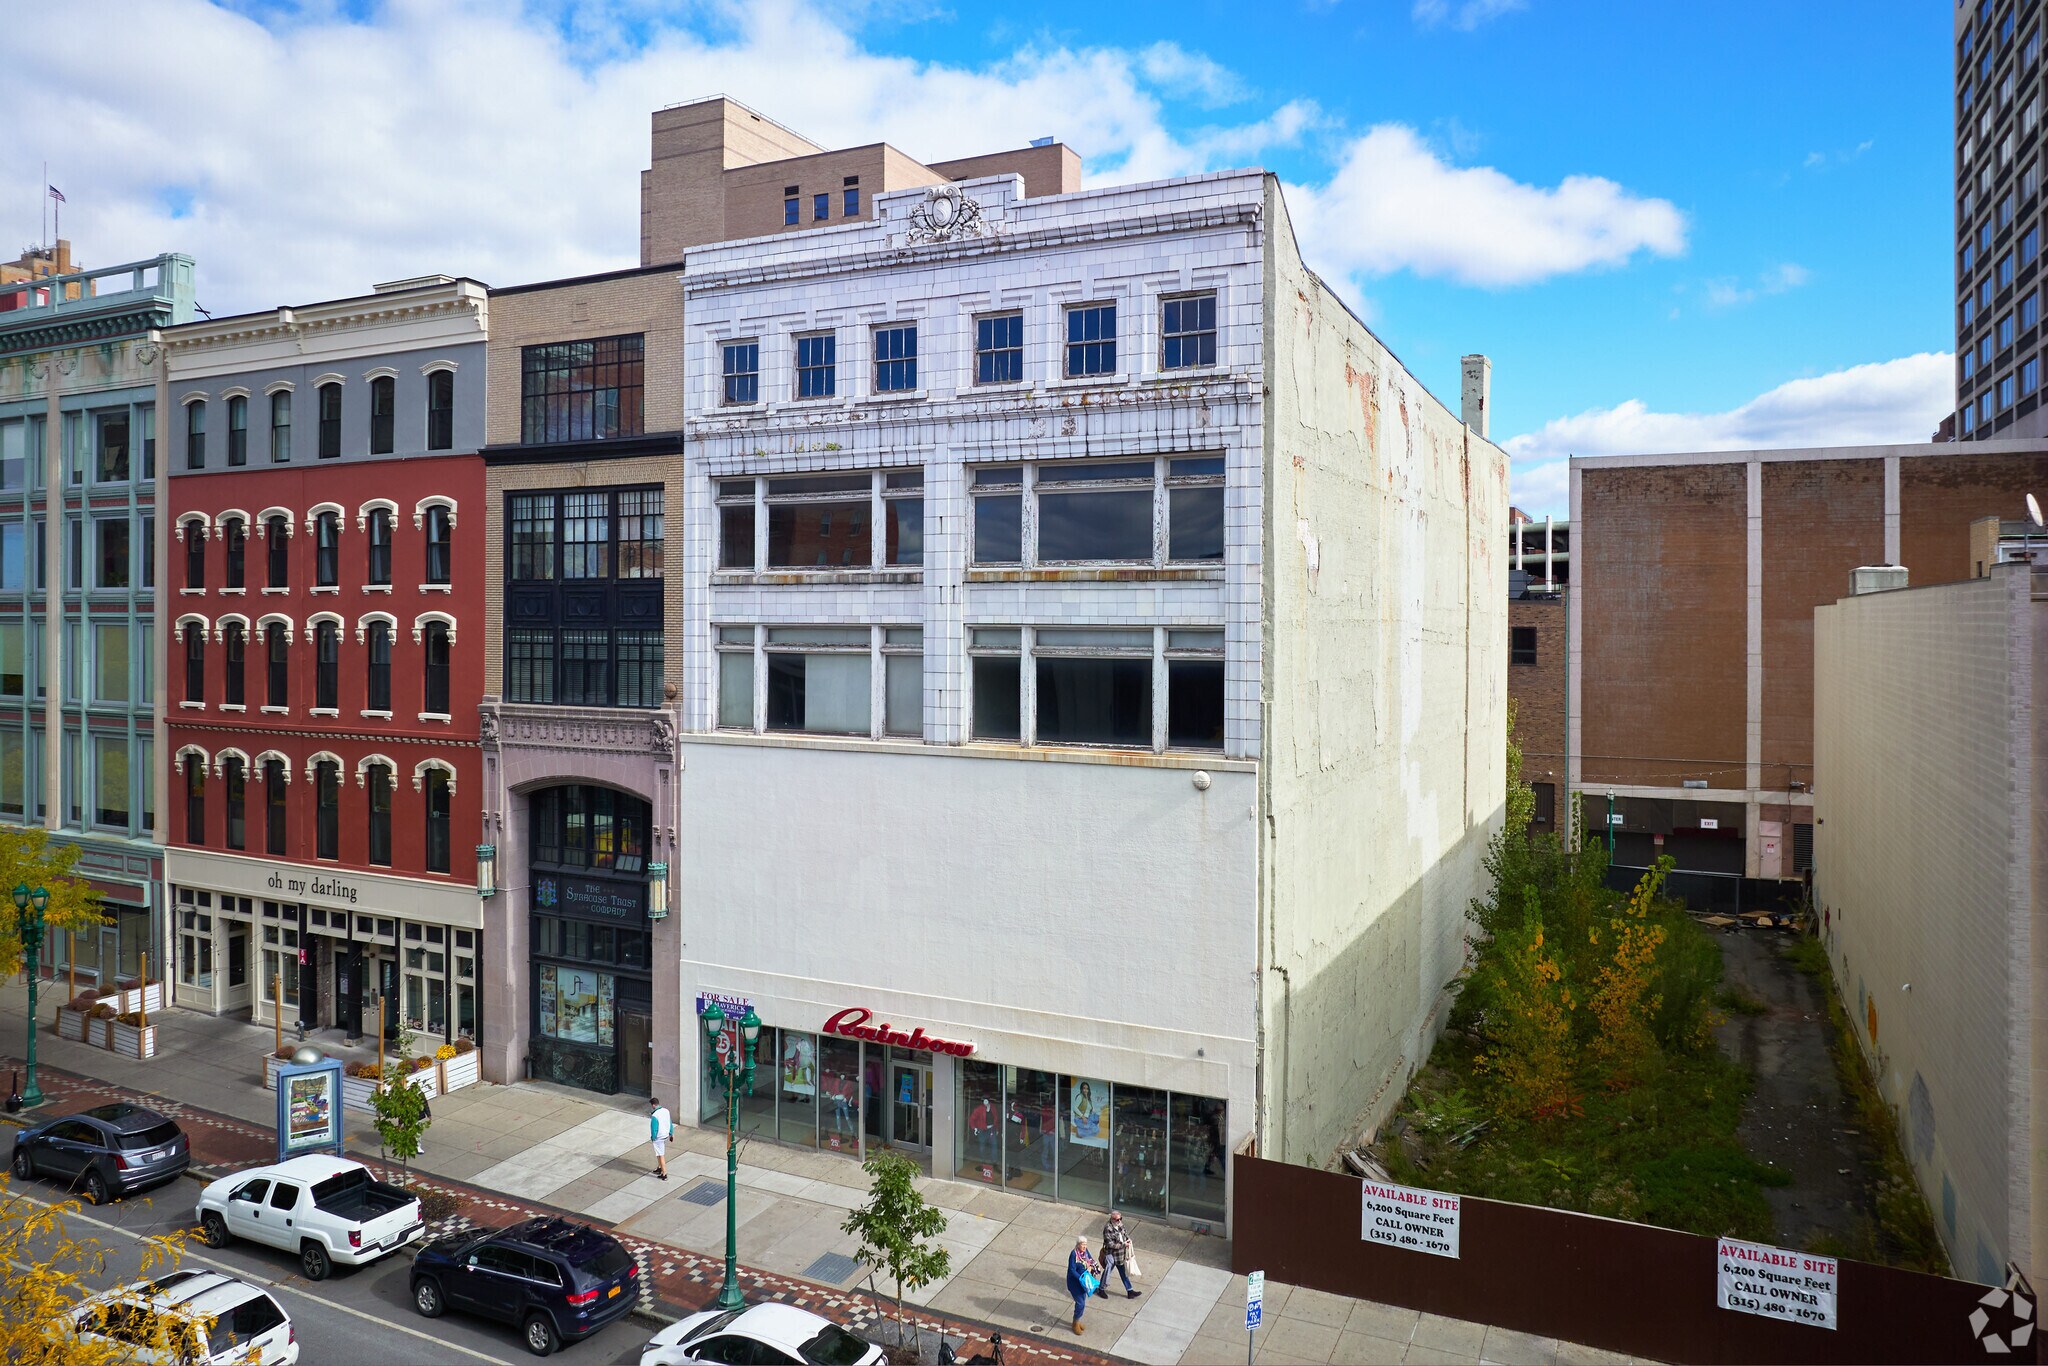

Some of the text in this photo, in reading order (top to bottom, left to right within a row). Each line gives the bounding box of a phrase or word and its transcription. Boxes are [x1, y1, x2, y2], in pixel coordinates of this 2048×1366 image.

[268, 871, 358, 903] oh my darling
[701, 991, 749, 1006] FOR SALE
[716, 1036, 728, 1049] 25
[823, 1007, 974, 1057] Rainbow
[1364, 1184, 1459, 1211] AVAILABLE SITE
[1366, 1201, 1455, 1225] 6,200 Square Feet
[1370, 1228, 1397, 1242] (315)
[1399, 1235, 1418, 1245] 480
[1426, 1240, 1450, 1251] 1670
[1375, 1217, 1444, 1238] CALL OWNER
[1720, 1244, 1836, 1275] AVAILABLE SITE
[1723, 1263, 1831, 1291] 6,200 Square Feet
[1735, 1281, 1819, 1306] CALL OWNER
[1728, 1294, 1760, 1311] (315)
[1763, 1302, 1786, 1313] 480
[1796, 1308, 1826, 1321] 1670
